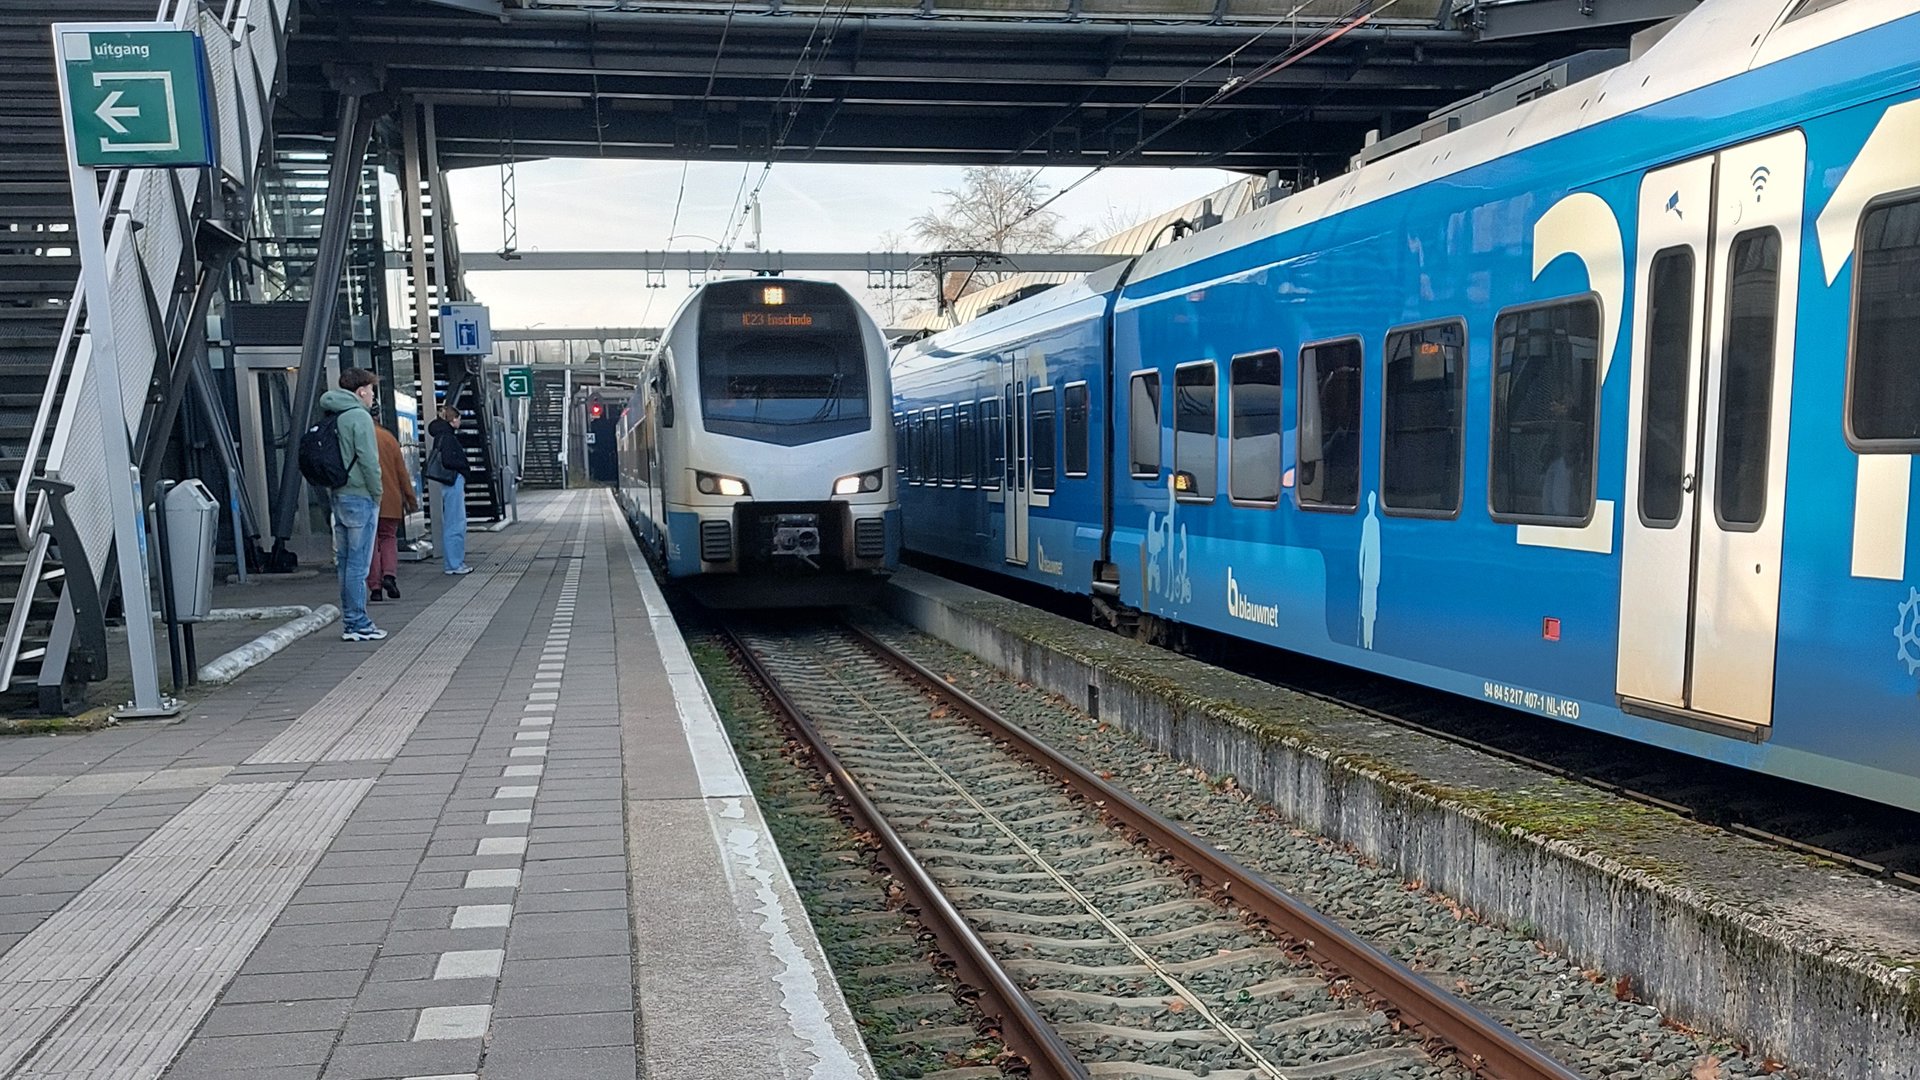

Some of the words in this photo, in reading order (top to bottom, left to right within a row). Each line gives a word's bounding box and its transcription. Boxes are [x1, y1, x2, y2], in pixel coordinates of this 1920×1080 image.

[94, 42, 150, 58] uitgang
[1239, 593, 1279, 628] blauwnet
[1484, 681, 1493, 698] 94
[1494, 684, 1503, 700] 84
[1503, 686, 1509, 702] 5
[1509, 687, 1524, 706] 217
[1524, 691, 1545, 711] 407-1
[1546, 696, 1580, 720] NL-KEO
